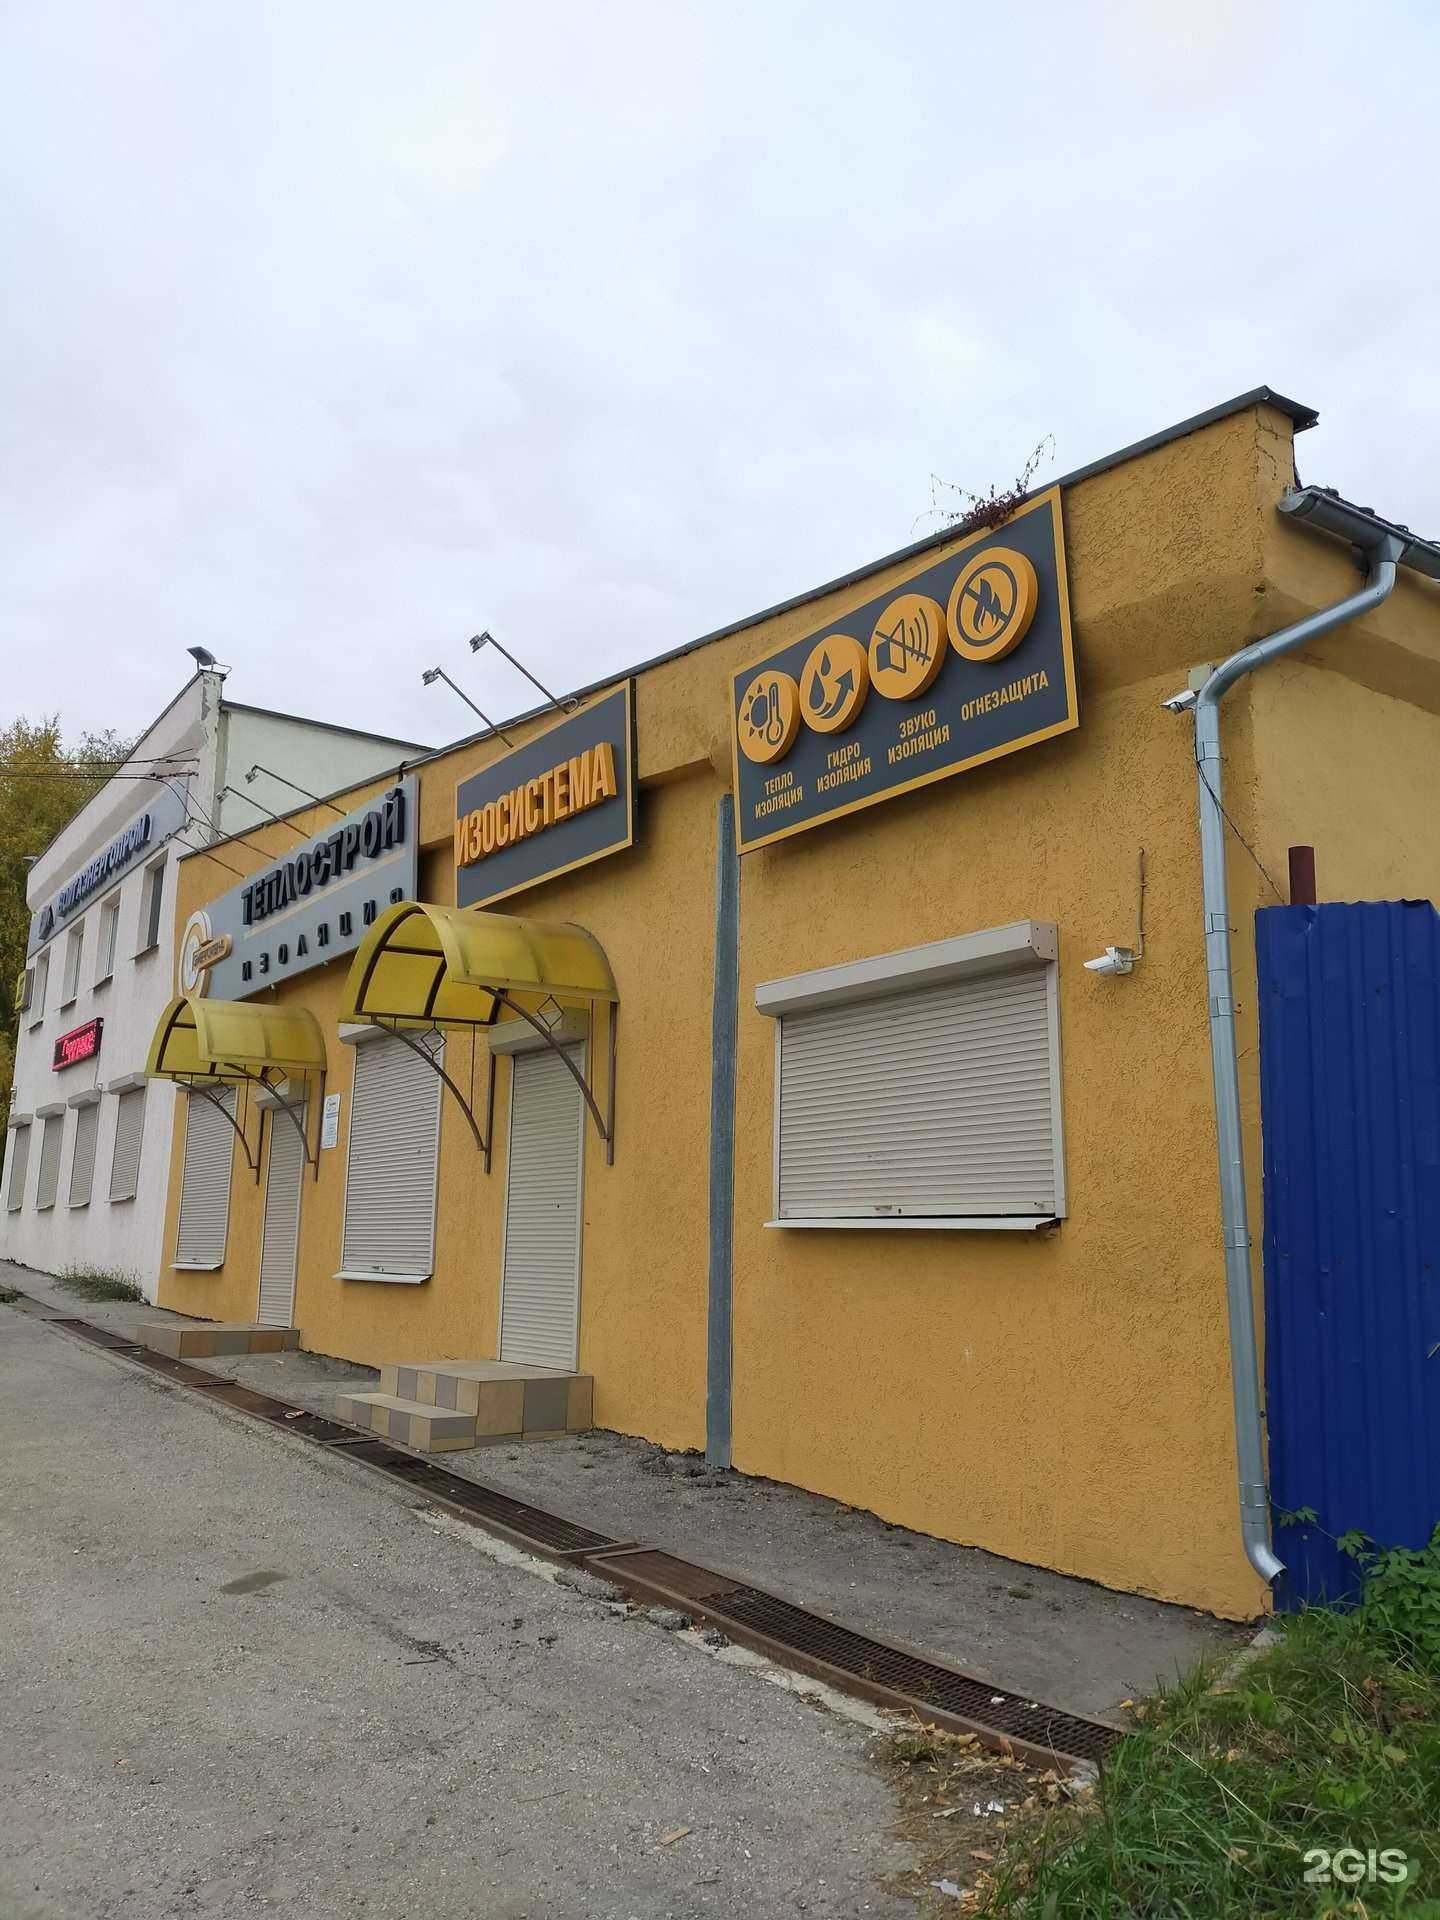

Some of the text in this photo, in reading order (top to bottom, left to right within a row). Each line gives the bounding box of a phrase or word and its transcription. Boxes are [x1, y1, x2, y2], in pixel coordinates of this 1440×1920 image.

[960, 670, 1049, 721] ОГНЕЗАЩИТА
[899, 709, 937, 739] ЗВУКО
[826, 742, 861, 769] ГИДРО
[887, 724, 950, 765] ИЗОЛЯЦИЯ
[764, 771, 793, 796] ТЕПЛО
[816, 757, 871, 793] ИЗОЛЯЦИЯ
[454, 742, 617, 868] ИЗОСИСТЕМА
[754, 786, 803, 819] ИЗОЛЯЦИЯ
[241, 788, 405, 925] ТЕПЛОСТРОЙ
[242, 887, 403, 982] ИЗОЛЯЦИЯ
